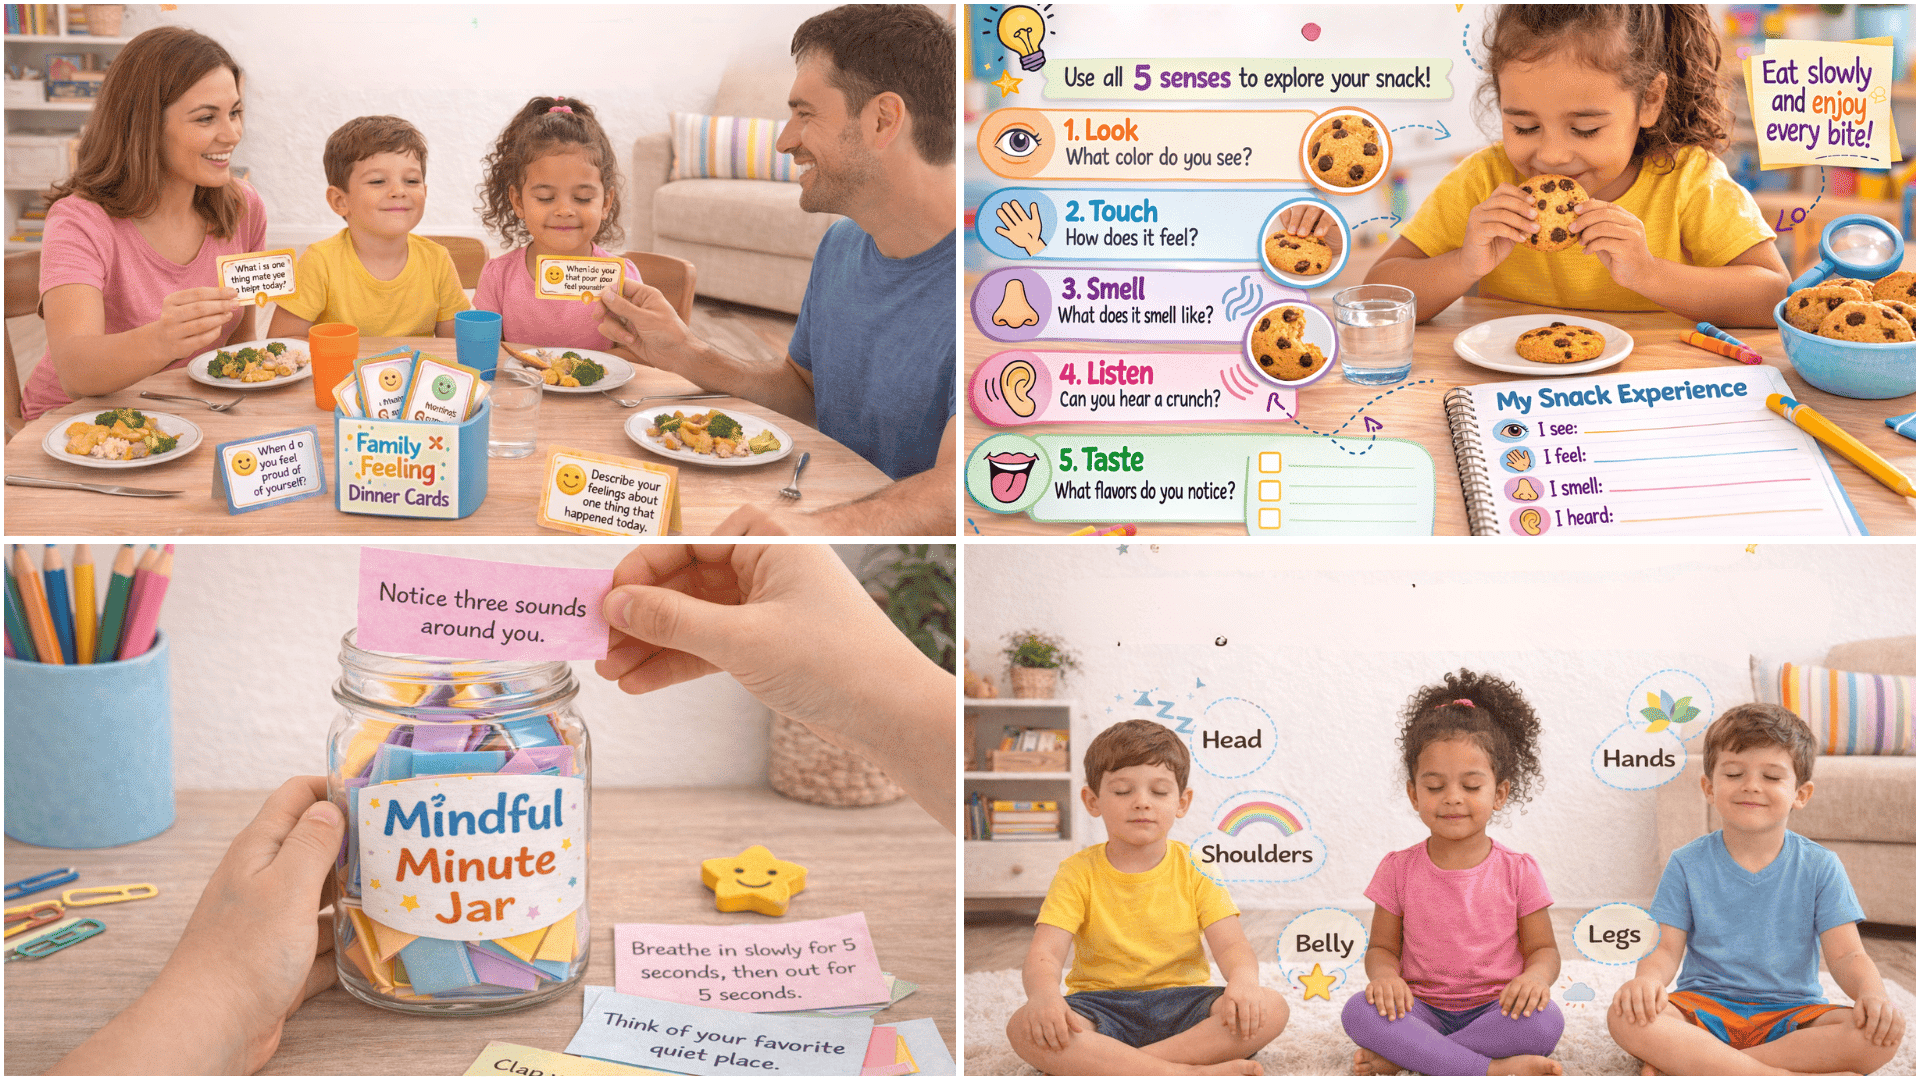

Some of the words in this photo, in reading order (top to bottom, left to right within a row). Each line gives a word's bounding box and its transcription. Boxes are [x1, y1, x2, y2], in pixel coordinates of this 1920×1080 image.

[1064, 66, 1095, 88] Use
[1103, 66, 1123, 88] all
[1133, 64, 1152, 91] 5
[1160, 70, 1231, 89] senses
[1239, 67, 1258, 88] to
[1264, 66, 1325, 93] explore
[1331, 73, 1370, 93] your
[1375, 66, 1431, 89] snack!
[1762, 59, 1799, 84] Eat
[1808, 56, 1872, 92] slowly
[1772, 86, 1806, 113] and
[1812, 90, 1867, 125] enjoy
[1063, 118, 1081, 142] 1.
[1085, 118, 1139, 142] Look
[1766, 122, 1820, 150] every
[1828, 119, 1873, 148] bite!
[1066, 148, 1110, 166] What
[1116, 148, 1153, 166] color
[1159, 148, 1178, 166] do
[1184, 154, 1211, 173] you
[1217, 148, 1252, 167] see?
[1065, 201, 1085, 222] 2.
[1089, 199, 1158, 223] Touch
[1066, 229, 1099, 247] How
[1104, 229, 1138, 247] does
[1143, 228, 1154, 247] it
[1159, 228, 1198, 247] feel?
[231, 275, 250, 284] thing
[1062, 278, 1082, 300] 3.
[1087, 277, 1145, 300] Smell
[1058, 305, 1095, 324] What
[1100, 305, 1128, 324] does
[1132, 305, 1141, 324] it
[1145, 305, 1176, 324] smell
[1181, 305, 1213, 324] like?
[1059, 362, 1082, 385] 4.
[1087, 360, 1153, 385] Listen
[1060, 391, 1086, 408] Can
[1091, 395, 1115, 414] you
[1120, 388, 1151, 408] hear
[1155, 395, 1164, 408] a
[1167, 390, 1221, 408] crunch?
[1497, 390, 1532, 414] My
[1538, 384, 1612, 408] Snack
[1617, 380, 1748, 408] Experience
[1538, 421, 1546, 437] I
[1550, 421, 1578, 436] see:
[257, 444, 287, 456] When
[357, 432, 421, 459] Family
[1544, 448, 1550, 464] I
[1555, 446, 1586, 464] feel:
[259, 459, 277, 471] you
[279, 453, 297, 464] feel
[361, 455, 435, 486] Feeling
[1060, 448, 1078, 472] 5.
[1082, 447, 1144, 472] Taste
[254, 486, 263, 496] of
[265, 476, 307, 496] yourself?
[262, 467, 290, 484] proud
[292, 464, 301, 475] of
[591, 469, 635, 487] Describe
[637, 480, 661, 492] your
[349, 484, 400, 505] Dinner
[405, 488, 450, 507] Cards
[588, 483, 626, 501] feelings
[628, 491, 659, 506] about
[1055, 482, 1091, 500] What
[1094, 482, 1137, 501] flavors
[1140, 479, 1156, 500] do
[1160, 488, 1183, 506] you
[1188, 482, 1236, 500] notice?
[1549, 481, 1557, 497] I
[1561, 478, 1603, 496] smell:
[564, 506, 614, 526] happened
[616, 517, 648, 534] today.
[582, 498, 602, 508] one
[604, 500, 630, 517] thing
[632, 506, 655, 520] that
[1555, 511, 1563, 527] I
[1567, 508, 1613, 526] heard:
[379, 581, 448, 607] Notice
[453, 589, 509, 613] three
[515, 597, 587, 617] sounds
[421, 620, 495, 640] around
[501, 629, 545, 645] you.
[383, 788, 563, 837] Mindful
[395, 847, 557, 884] Minute
[435, 891, 515, 924] Jar
[631, 941, 711, 957] Breathe
[719, 943, 738, 957] in
[745, 942, 802, 961] slowly
[808, 940, 836, 956] for
[842, 937, 857, 952] 5
[641, 966, 727, 981] seconds,
[732, 964, 780, 978] then
[785, 963, 819, 977] out
[826, 960, 857, 976] for
[698, 988, 712, 1002] 5
[719, 984, 803, 1000] seconds.
[603, 1011, 660, 1033] Think
[665, 1023, 693, 1038] of
[695, 1030, 747, 1045] your
[754, 1035, 847, 1056] favorite
[493, 1058, 544, 1076] Clap
[649, 1042, 708, 1062] quiet
[714, 1050, 780, 1071] place.
